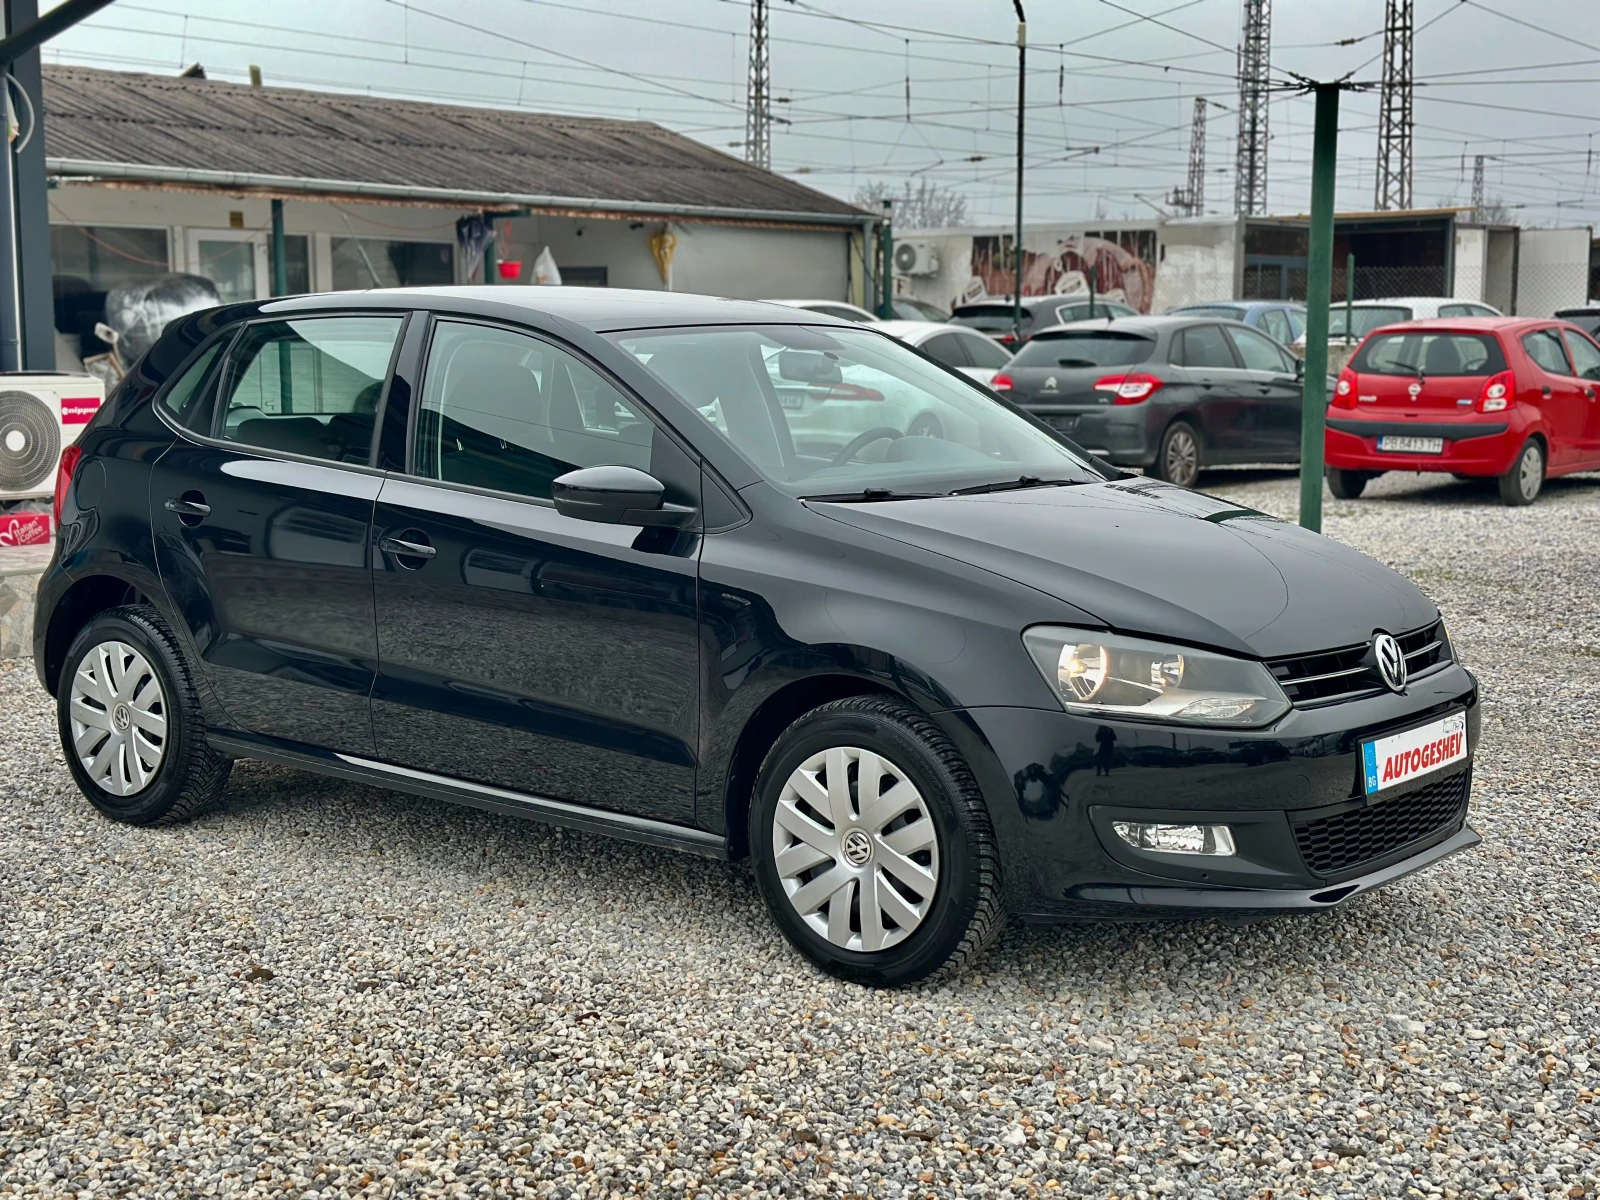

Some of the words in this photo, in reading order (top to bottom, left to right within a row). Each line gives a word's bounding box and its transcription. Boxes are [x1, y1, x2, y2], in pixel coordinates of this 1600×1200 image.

[20, 525, 43, 543] Coffee
[1382, 731, 1463, 783] AUTOGESHEV
[1368, 775, 1377, 788] BG
